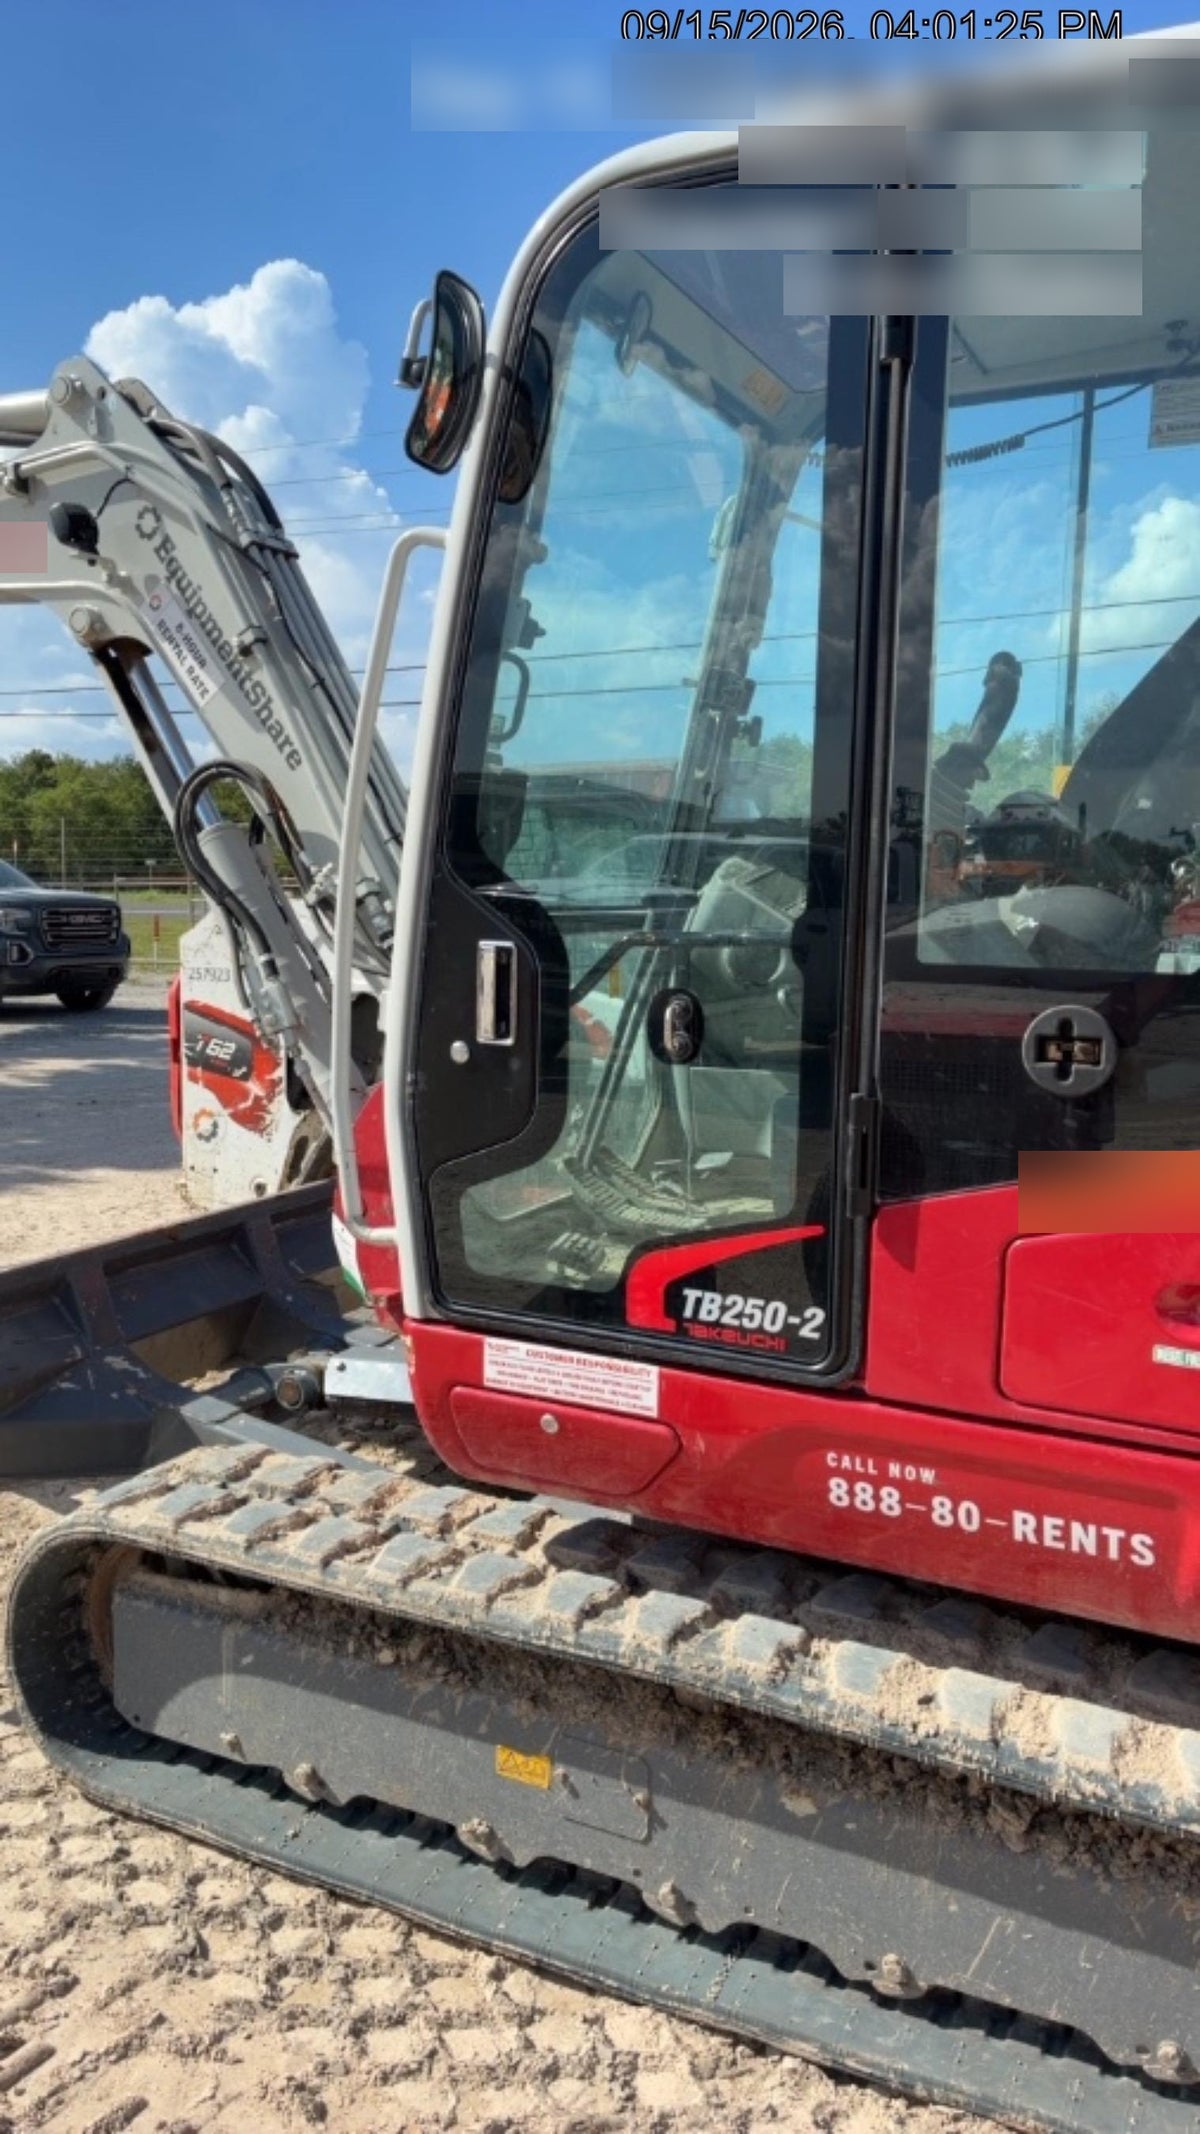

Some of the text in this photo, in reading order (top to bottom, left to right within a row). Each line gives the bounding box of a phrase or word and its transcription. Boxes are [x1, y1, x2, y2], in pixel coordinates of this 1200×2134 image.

[153, 532, 302, 771] EquipmentShare
[157, 618, 210, 699] RENTAL RATE
[682, 1288, 826, 1340] TB250-2
[827, 1451, 935, 1485] CALL NOW
[828, 1477, 1156, 1566] 888-80-RENTS
